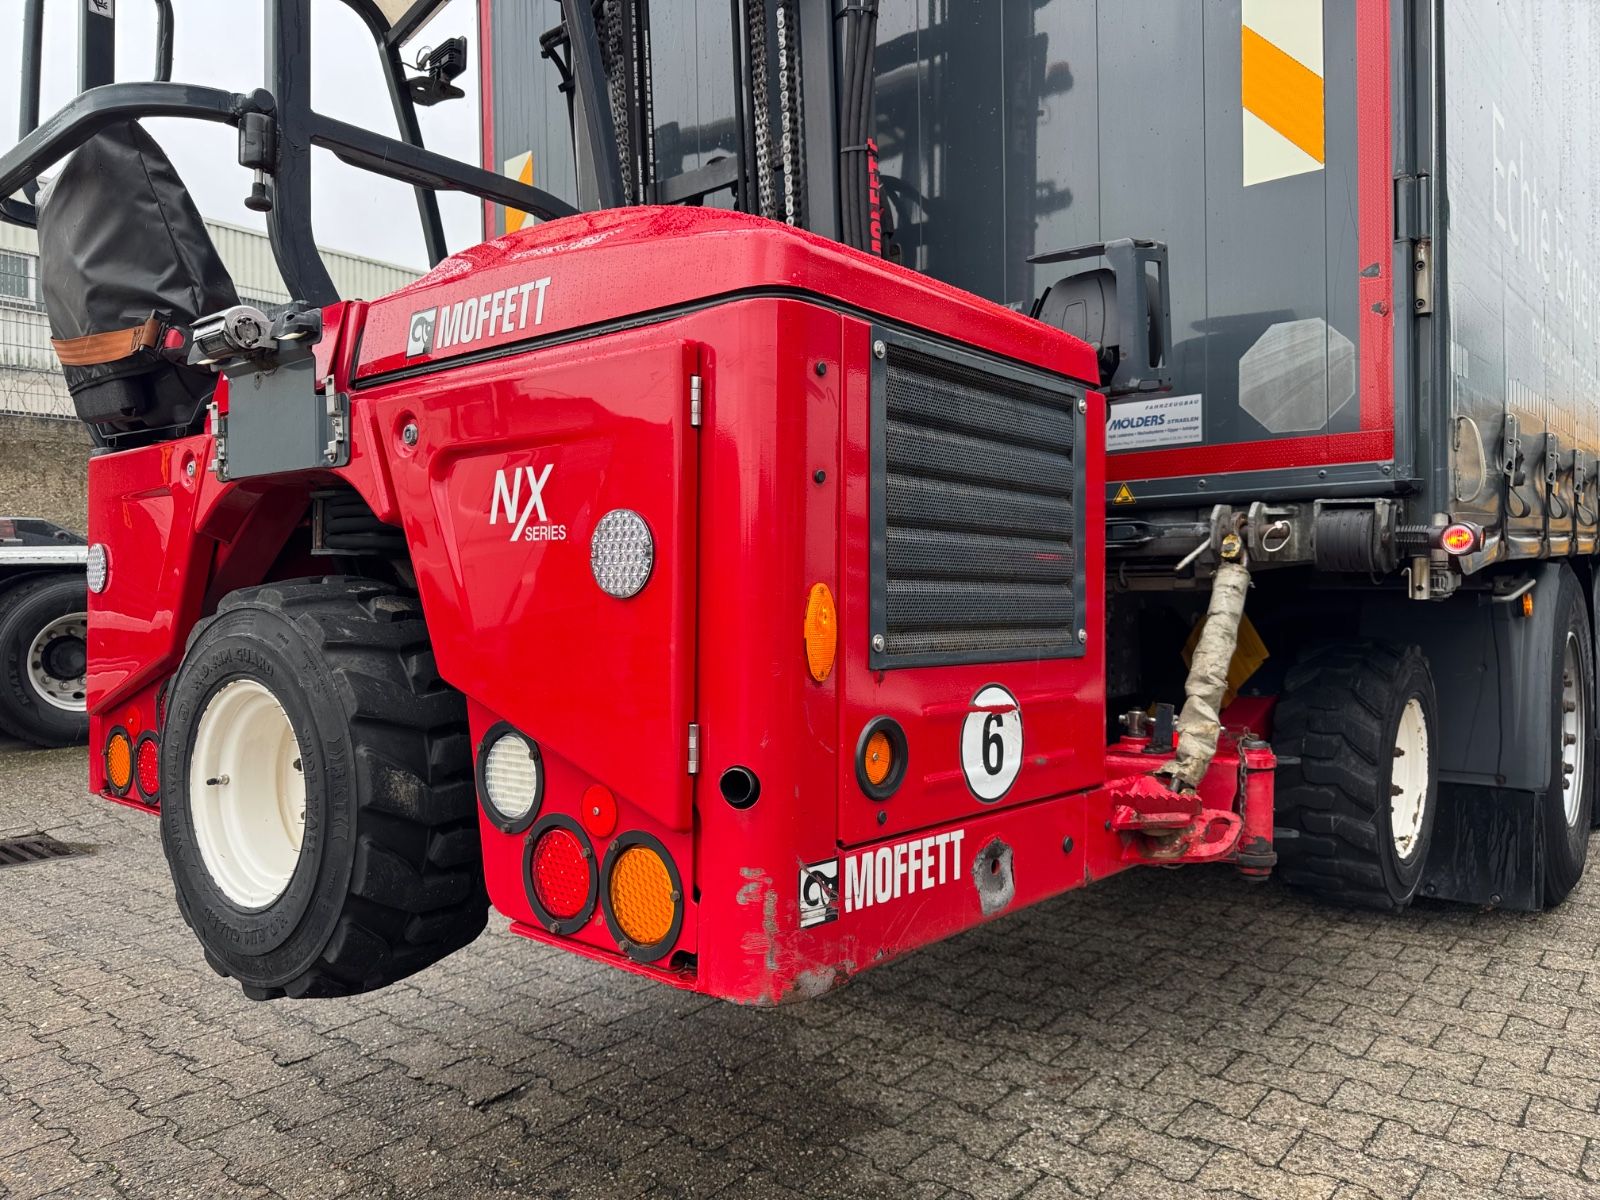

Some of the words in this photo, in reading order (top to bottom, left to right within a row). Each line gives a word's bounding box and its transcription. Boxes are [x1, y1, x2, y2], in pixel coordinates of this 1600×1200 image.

[1493, 102, 1550, 285] Echte
[1555, 205, 1600, 346] Expert
[436, 276, 552, 350] MOFFETT
[1108, 414, 1165, 431] MÖLDERS
[1145, 400, 1199, 410] FAHRZEUGBAU
[489, 463, 554, 541] NX
[524, 524, 567, 541] SERIES
[982, 712, 1004, 776] 6
[845, 829, 965, 913] MOFFETT
